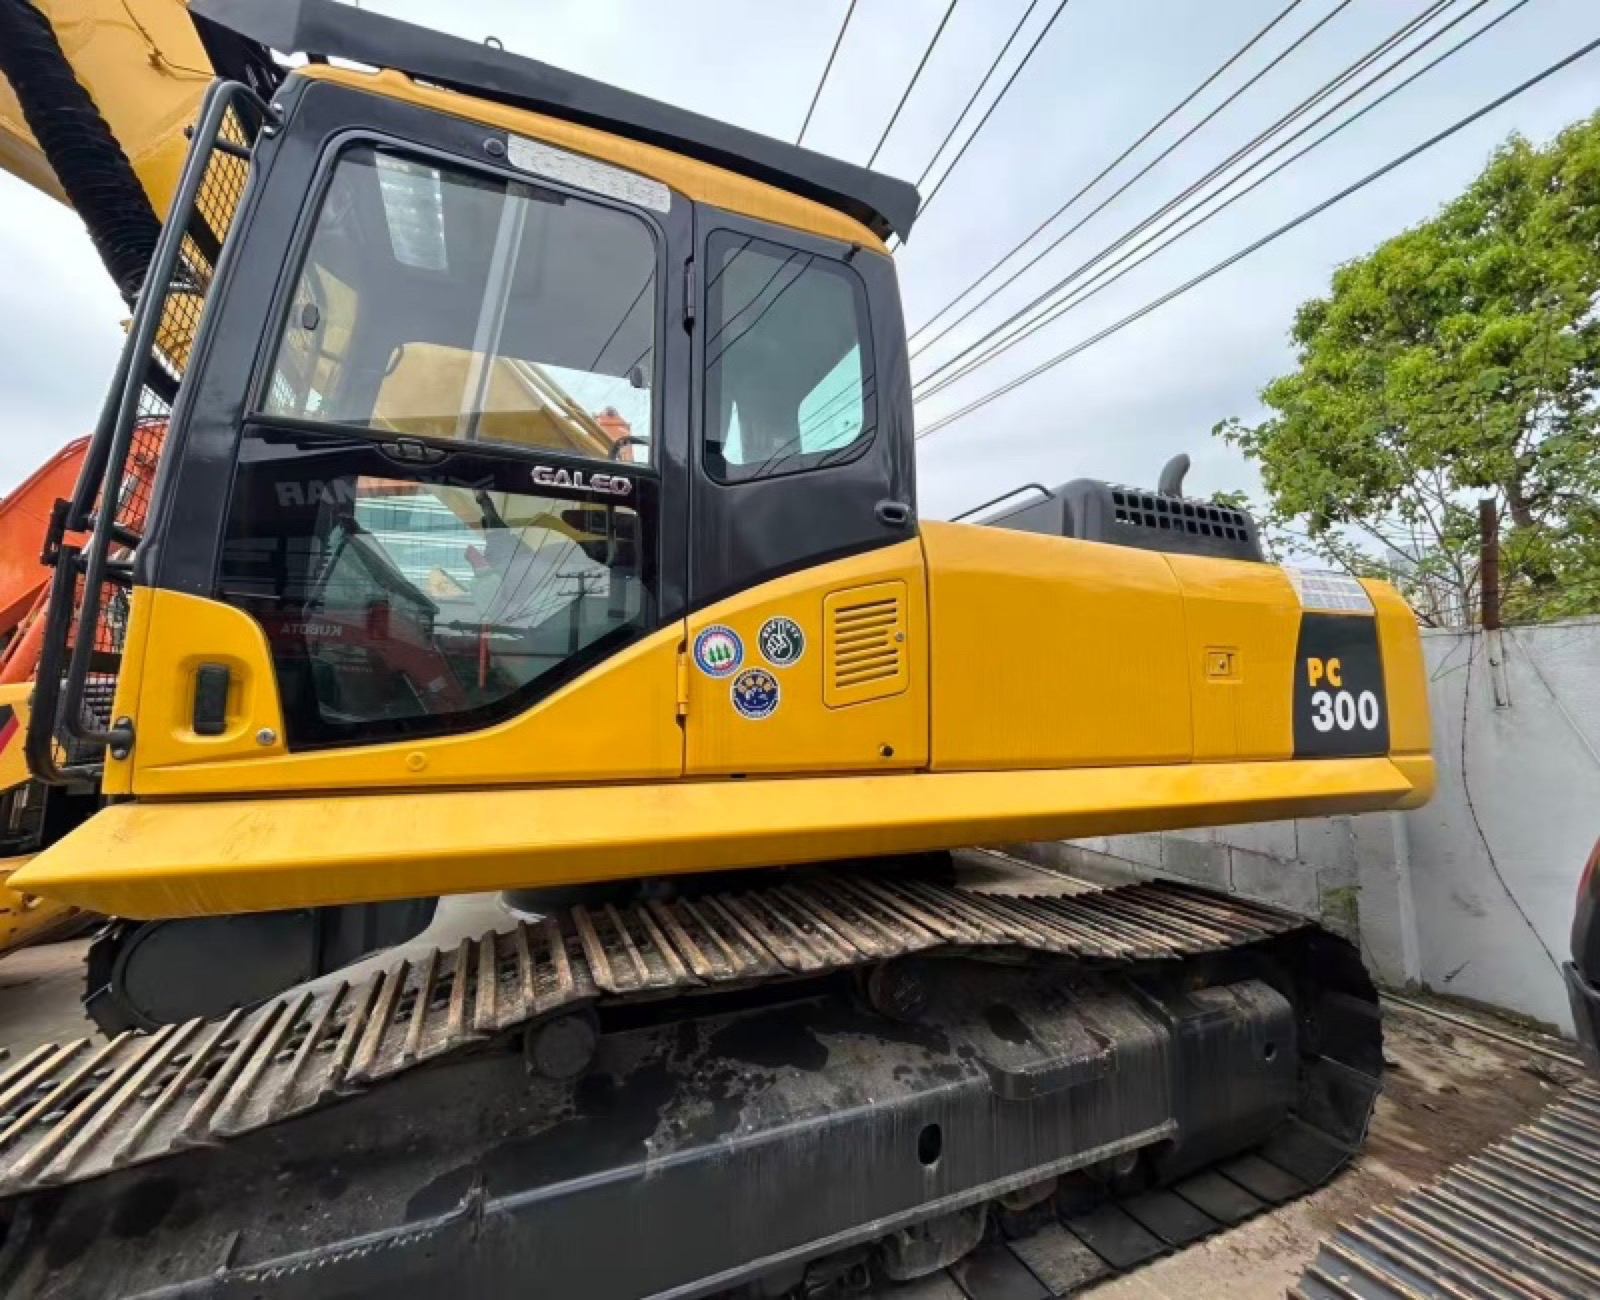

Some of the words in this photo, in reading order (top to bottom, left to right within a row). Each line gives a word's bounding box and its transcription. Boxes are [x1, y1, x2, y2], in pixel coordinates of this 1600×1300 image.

[530, 465, 632, 496] GALEO
[1307, 657, 1342, 687] PC
[1311, 690, 1379, 732] 300
